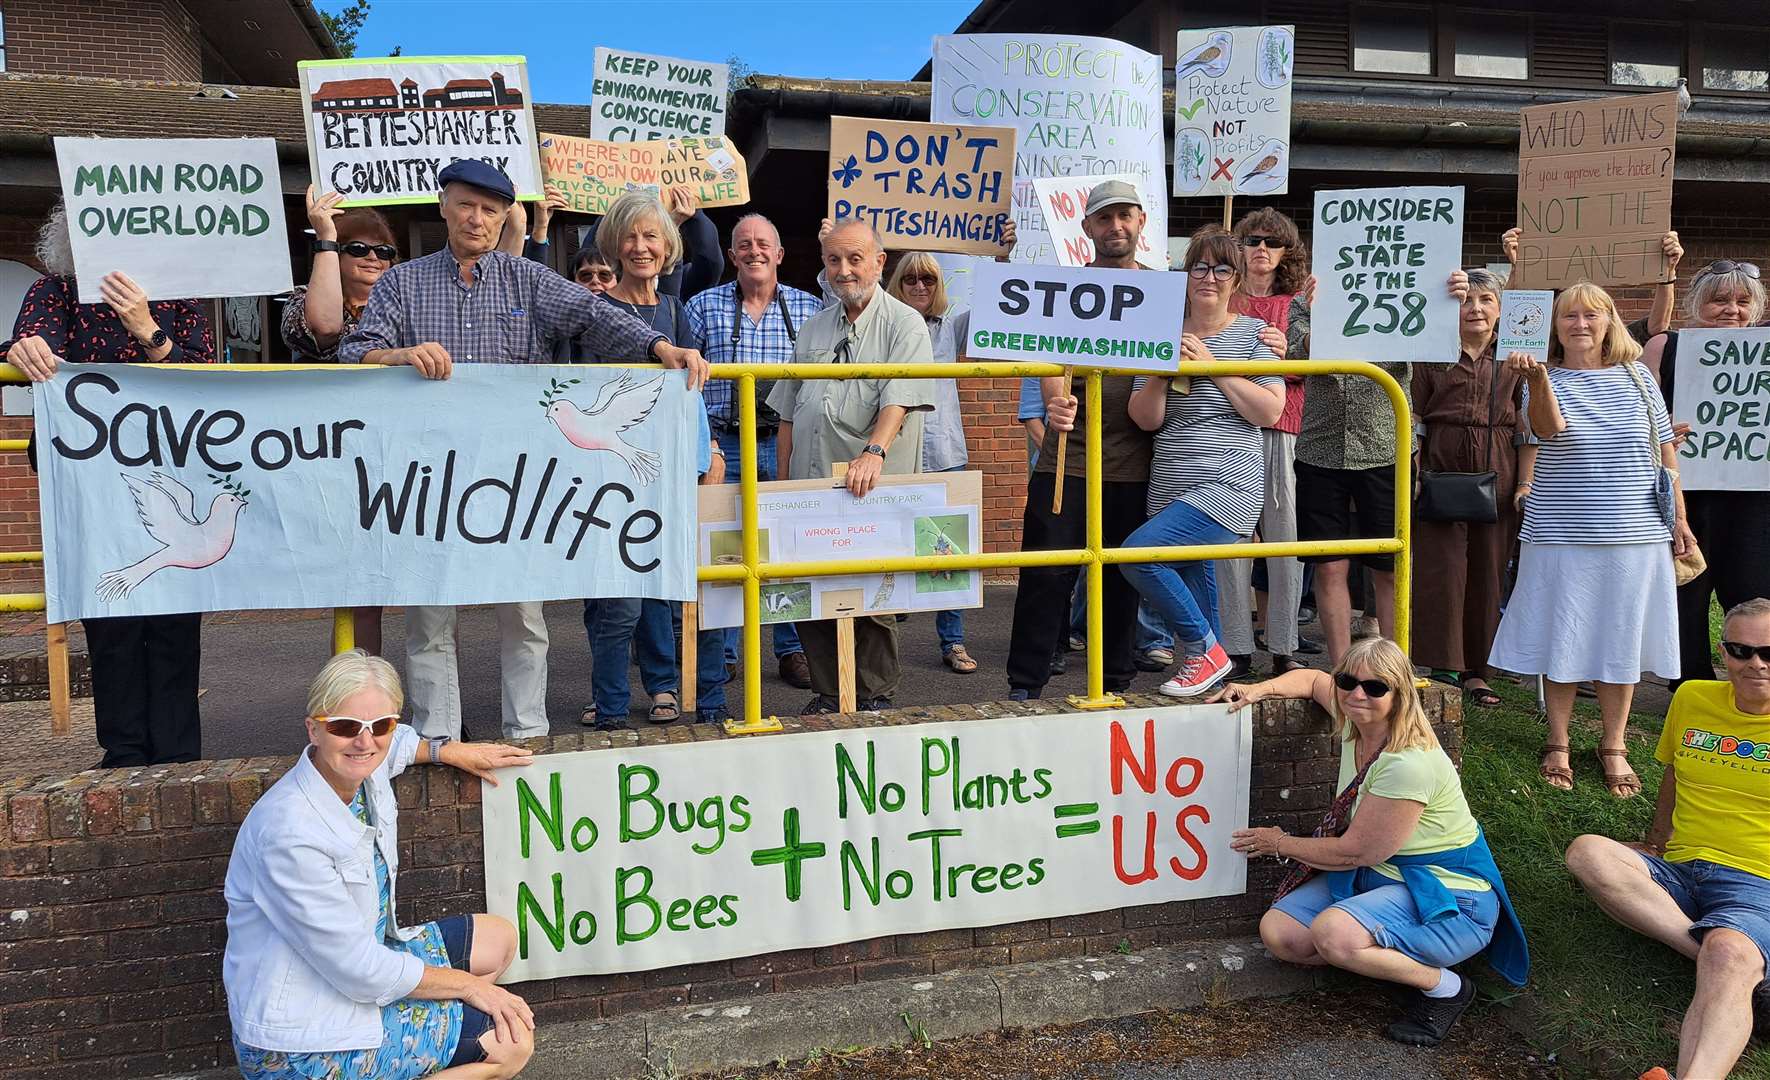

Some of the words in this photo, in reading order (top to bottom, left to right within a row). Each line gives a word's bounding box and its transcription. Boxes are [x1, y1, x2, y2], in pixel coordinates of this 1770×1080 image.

[605, 53, 659, 78] KEEP
[667, 63, 713, 87] YOUR
[1004, 40, 1123, 83] PROTECT
[592, 79, 724, 114] ENVIRONMENTAL
[1189, 75, 1252, 100] Protect
[600, 101, 712, 136] CONSCIENCE
[951, 83, 1148, 129] CONSERVATION
[1207, 96, 1280, 115] Nature
[322, 110, 522, 149] BETTESHANGER
[1024, 122, 1096, 149] AREA
[1213, 119, 1246, 137] NOT
[1213, 132, 1266, 154] Profits
[1524, 110, 1586, 149] WHO
[1602, 104, 1666, 145] WINS
[554, 139, 619, 163] WHERE
[629, 148, 653, 165] DO
[661, 146, 704, 165] AVE
[865, 128, 998, 173] DON'T
[74, 164, 163, 196] MAIN
[174, 163, 264, 194] ROAD
[331, 157, 441, 195] COUNTRY
[547, 156, 578, 175] WE
[583, 160, 608, 179] GO
[661, 166, 702, 185] OUR
[1520, 159, 1533, 190] if
[1538, 168, 1558, 192] you
[1563, 166, 1601, 189] approve
[1606, 158, 1625, 177] the
[700, 181, 739, 202] LIFE
[874, 166, 1002, 203] TRASH
[78, 204, 270, 237] OVERLOAD
[1049, 190, 1076, 222] NO
[1321, 198, 1454, 225] CONSIDER
[1520, 196, 1589, 234] NOT
[1597, 189, 1662, 226] THE
[1064, 235, 1092, 265] NO
[1365, 225, 1406, 244] THE
[1334, 243, 1426, 271] STATE
[1341, 273, 1368, 290] OF
[1373, 271, 1417, 290] THE
[998, 278, 1145, 322] STOP
[1342, 291, 1427, 337] 258
[973, 330, 1174, 361] GREENWASHING
[1500, 338, 1523, 346] Silent
[1525, 339, 1546, 347] Earth
[1712, 370, 1770, 396] OUR
[52, 372, 246, 472] Save
[250, 418, 366, 470] our
[1680, 431, 1770, 462] SPAC
[354, 448, 663, 574] Wildlife
[758, 500, 821, 512] TTESHANGER
[852, 496, 896, 506] COUNTRY
[898, 494, 923, 504] PARK
[804, 527, 841, 537] WRONG
[847, 525, 878, 534] PLACE
[832, 539, 852, 548] FOR
[1110, 718, 1204, 797] No
[1682, 728, 1721, 752] THE
[1718, 735, 1770, 762] DOC
[835, 740, 906, 819] No
[921, 735, 1053, 816] Plants
[516, 772, 599, 858] No
[618, 763, 751, 855] Bugs
[1113, 804, 1211, 885] US
[840, 836, 913, 911] No
[907, 828, 1045, 902] Trees
[517, 873, 597, 960] No
[616, 865, 739, 946] Bees
